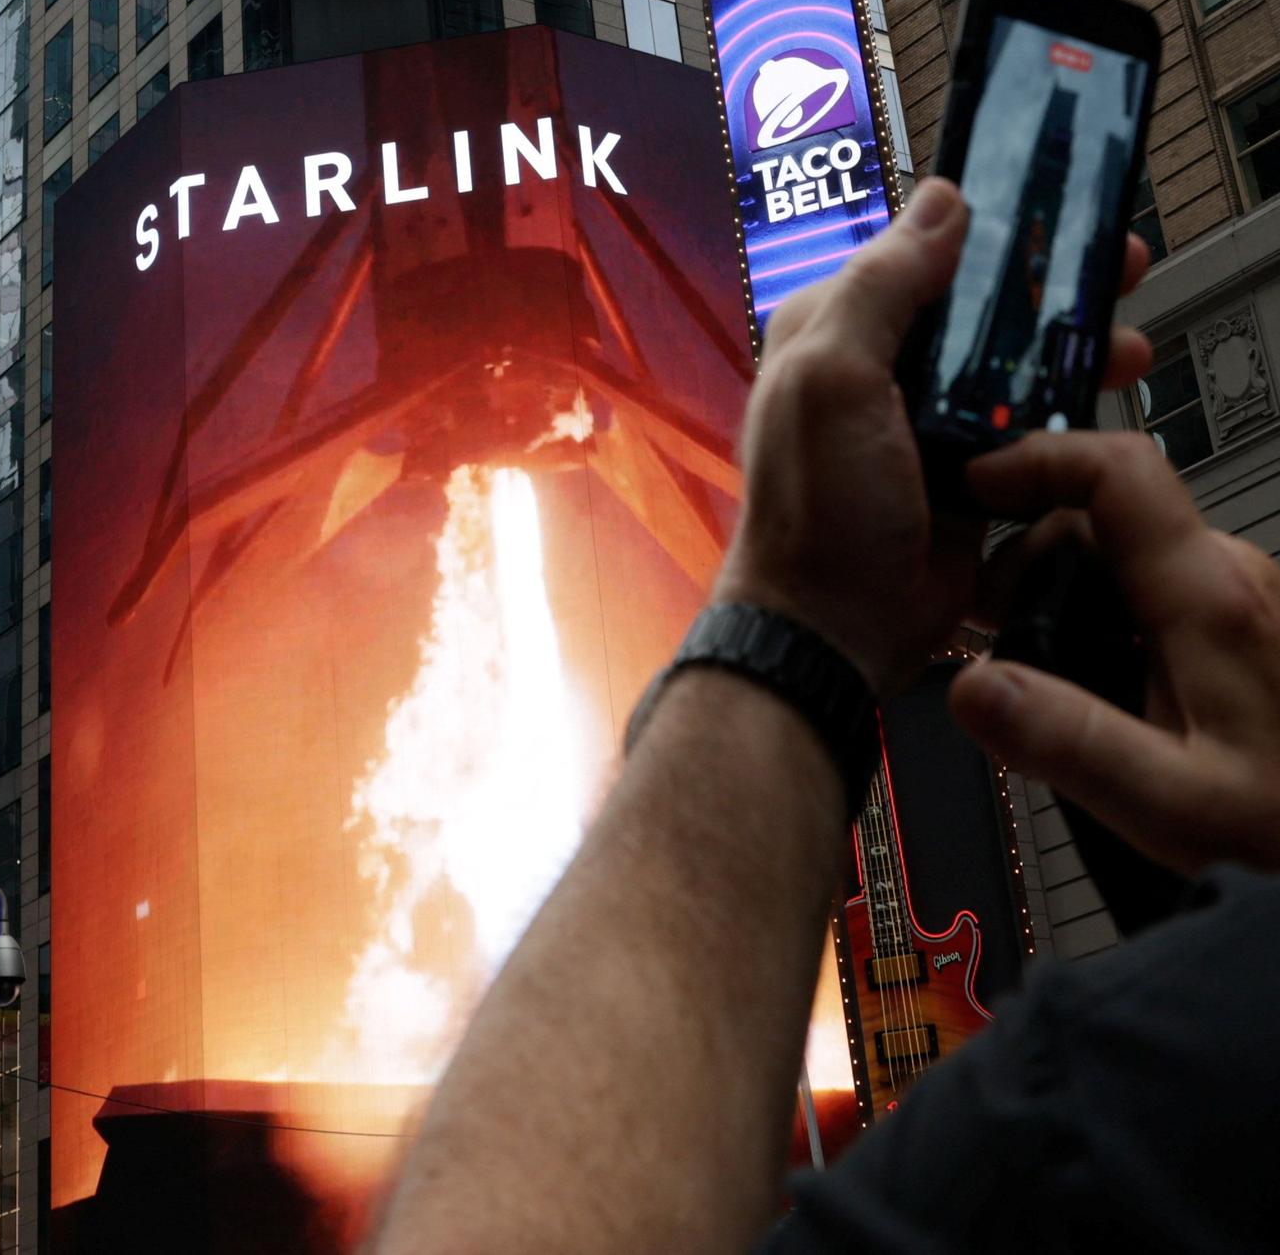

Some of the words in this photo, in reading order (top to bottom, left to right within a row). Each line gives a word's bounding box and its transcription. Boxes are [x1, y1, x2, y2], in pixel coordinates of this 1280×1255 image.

[752, 138, 862, 191] TACO
[135, 117, 628, 272] STARLINK
[765, 171, 868, 223] BELL
[933, 951, 962, 971] Gibson
